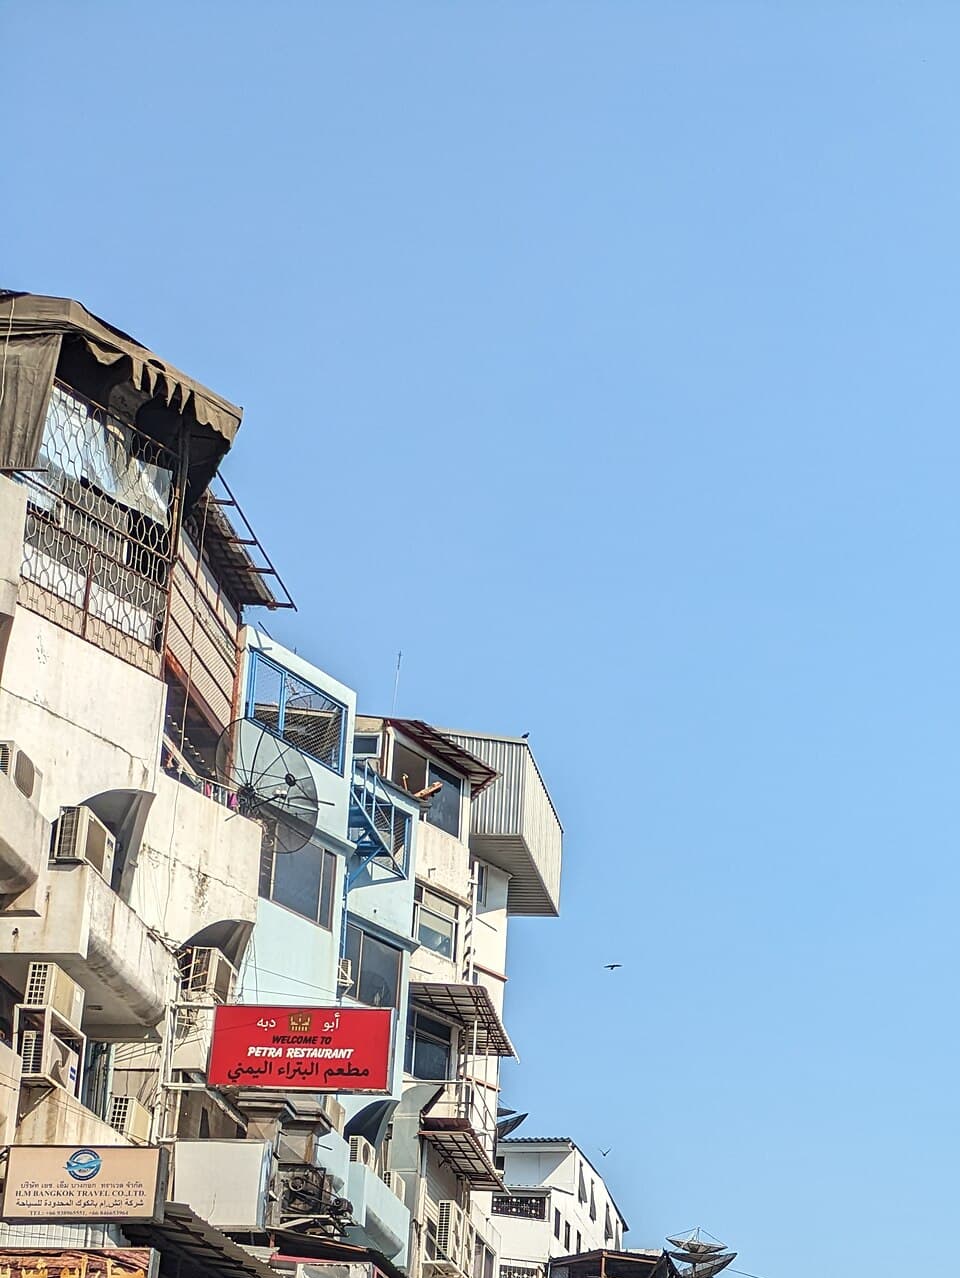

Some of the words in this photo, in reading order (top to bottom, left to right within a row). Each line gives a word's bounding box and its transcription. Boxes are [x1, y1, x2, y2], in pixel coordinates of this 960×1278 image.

[272, 1035, 317, 1045] WELCOME
[320, 1036, 332, 1045] TO
[247, 1047, 282, 1058] PETRA
[286, 1048, 354, 1059] RESTAURANT
[227, 1060, 273, 1083] اليمني
[323, 1061, 370, 1084] مطعم
